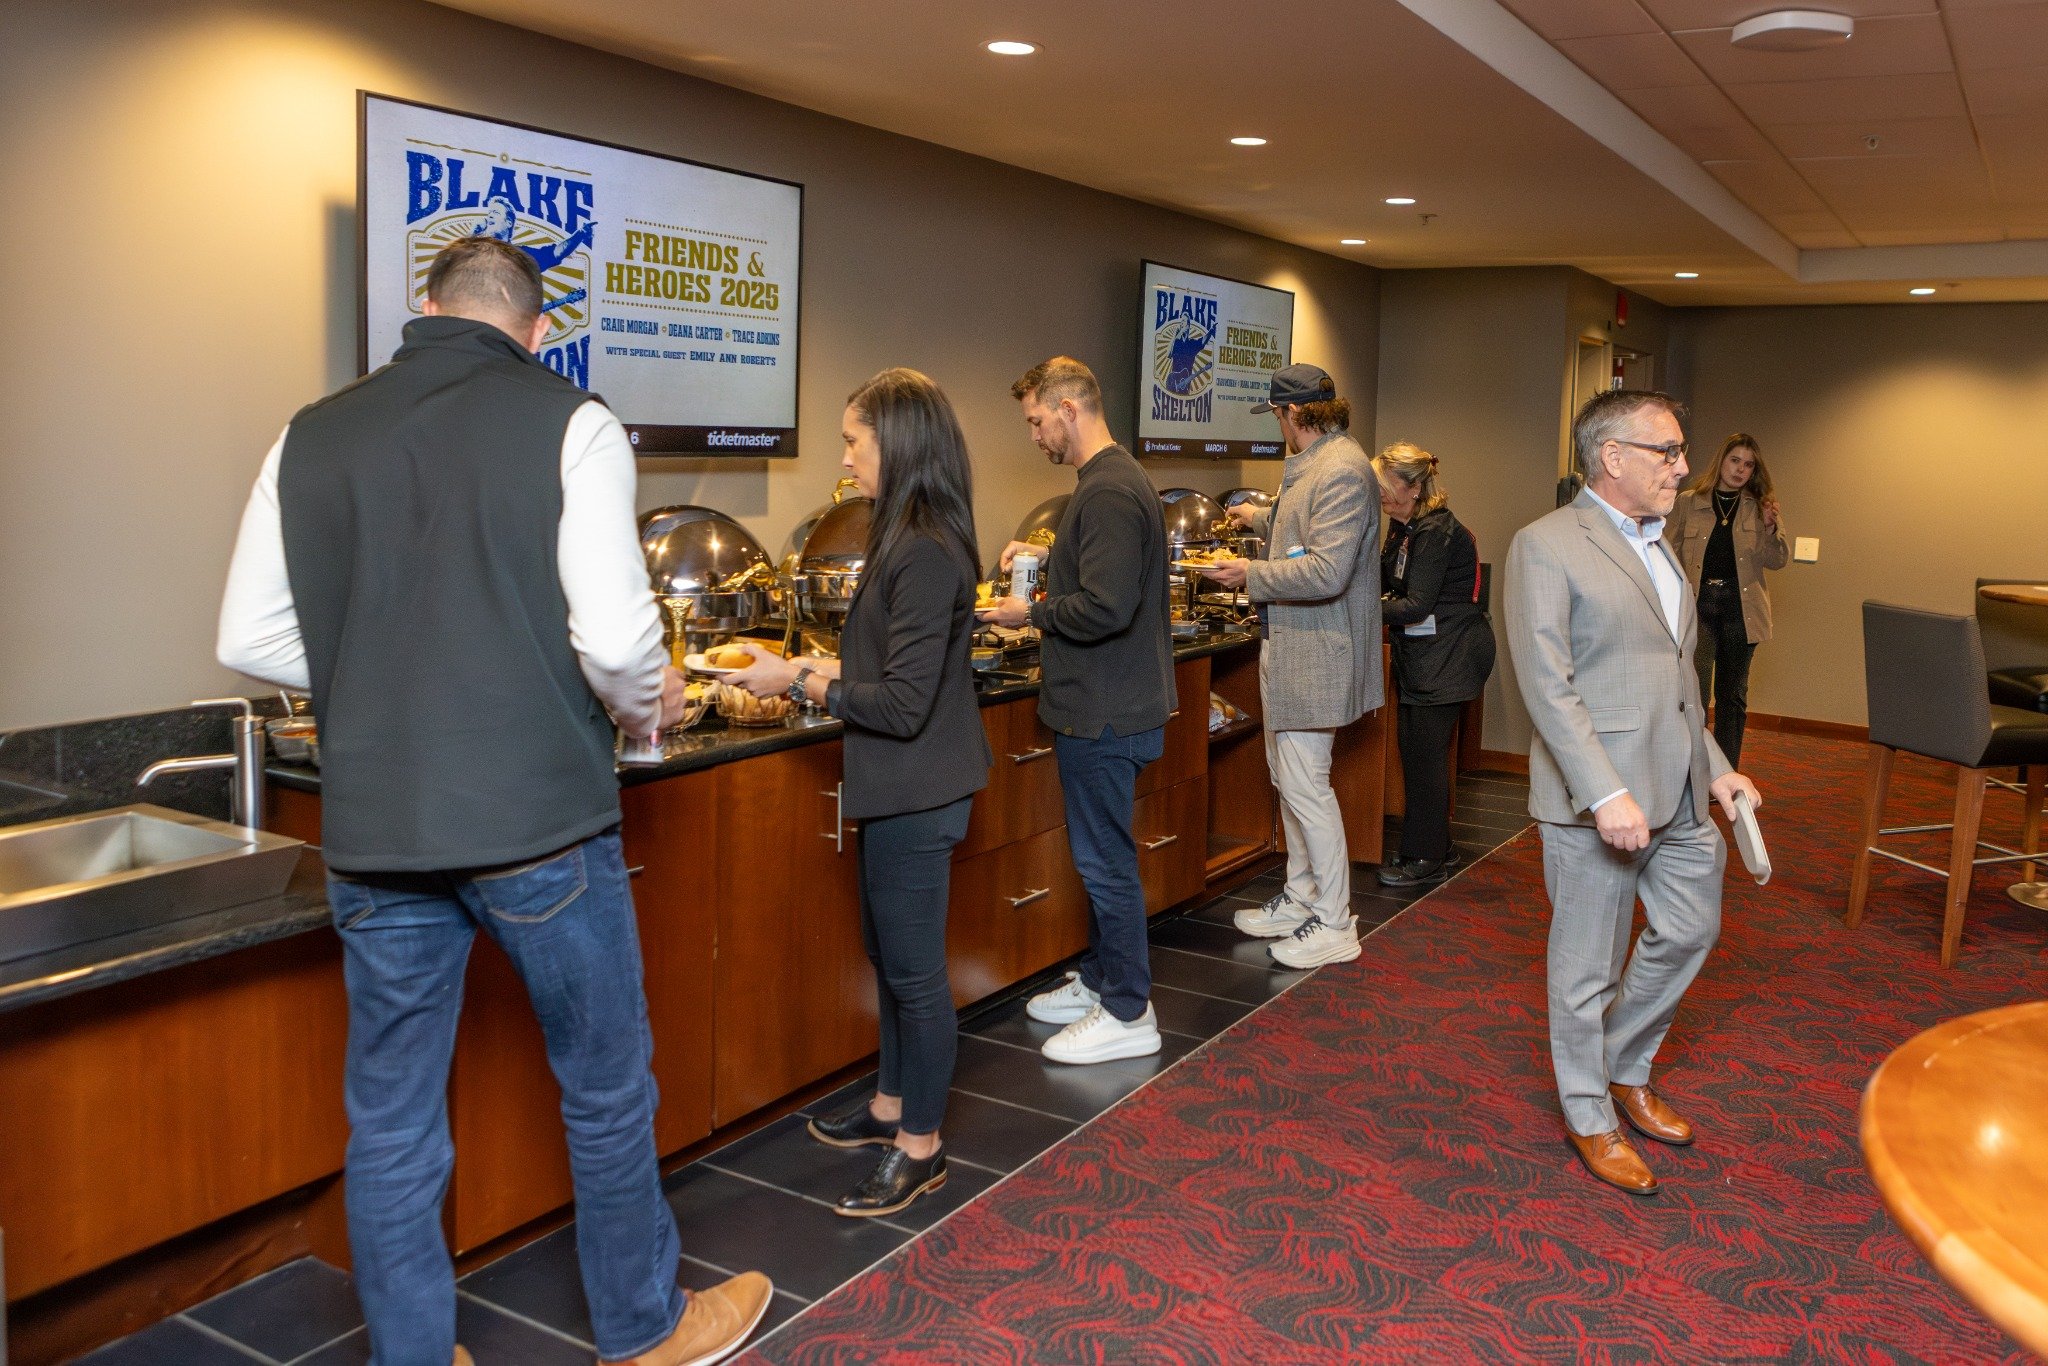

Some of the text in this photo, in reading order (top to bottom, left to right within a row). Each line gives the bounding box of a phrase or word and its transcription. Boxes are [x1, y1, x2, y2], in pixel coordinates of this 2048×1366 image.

[406, 150, 594, 250] BLAKE
[625, 229, 766, 278] FRIENDS &
[605, 261, 779, 312] HEROES 2025
[1155, 290, 1218, 340] BLAKE
[601, 317, 780, 346] CRAIG MORGAN DEANA CARTER TRACE ADKINS
[1226, 326, 1278, 351] FRIENDS &
[605, 346, 777, 367] WITH SPECIAL GUEST EMILY ANN ROBERTS
[1219, 345, 1283, 371] HEROES 2025
[1152, 384, 1213, 423] SHELTON
[630, 431, 639, 445] 6
[1204, 443, 1223, 452] MARCH
